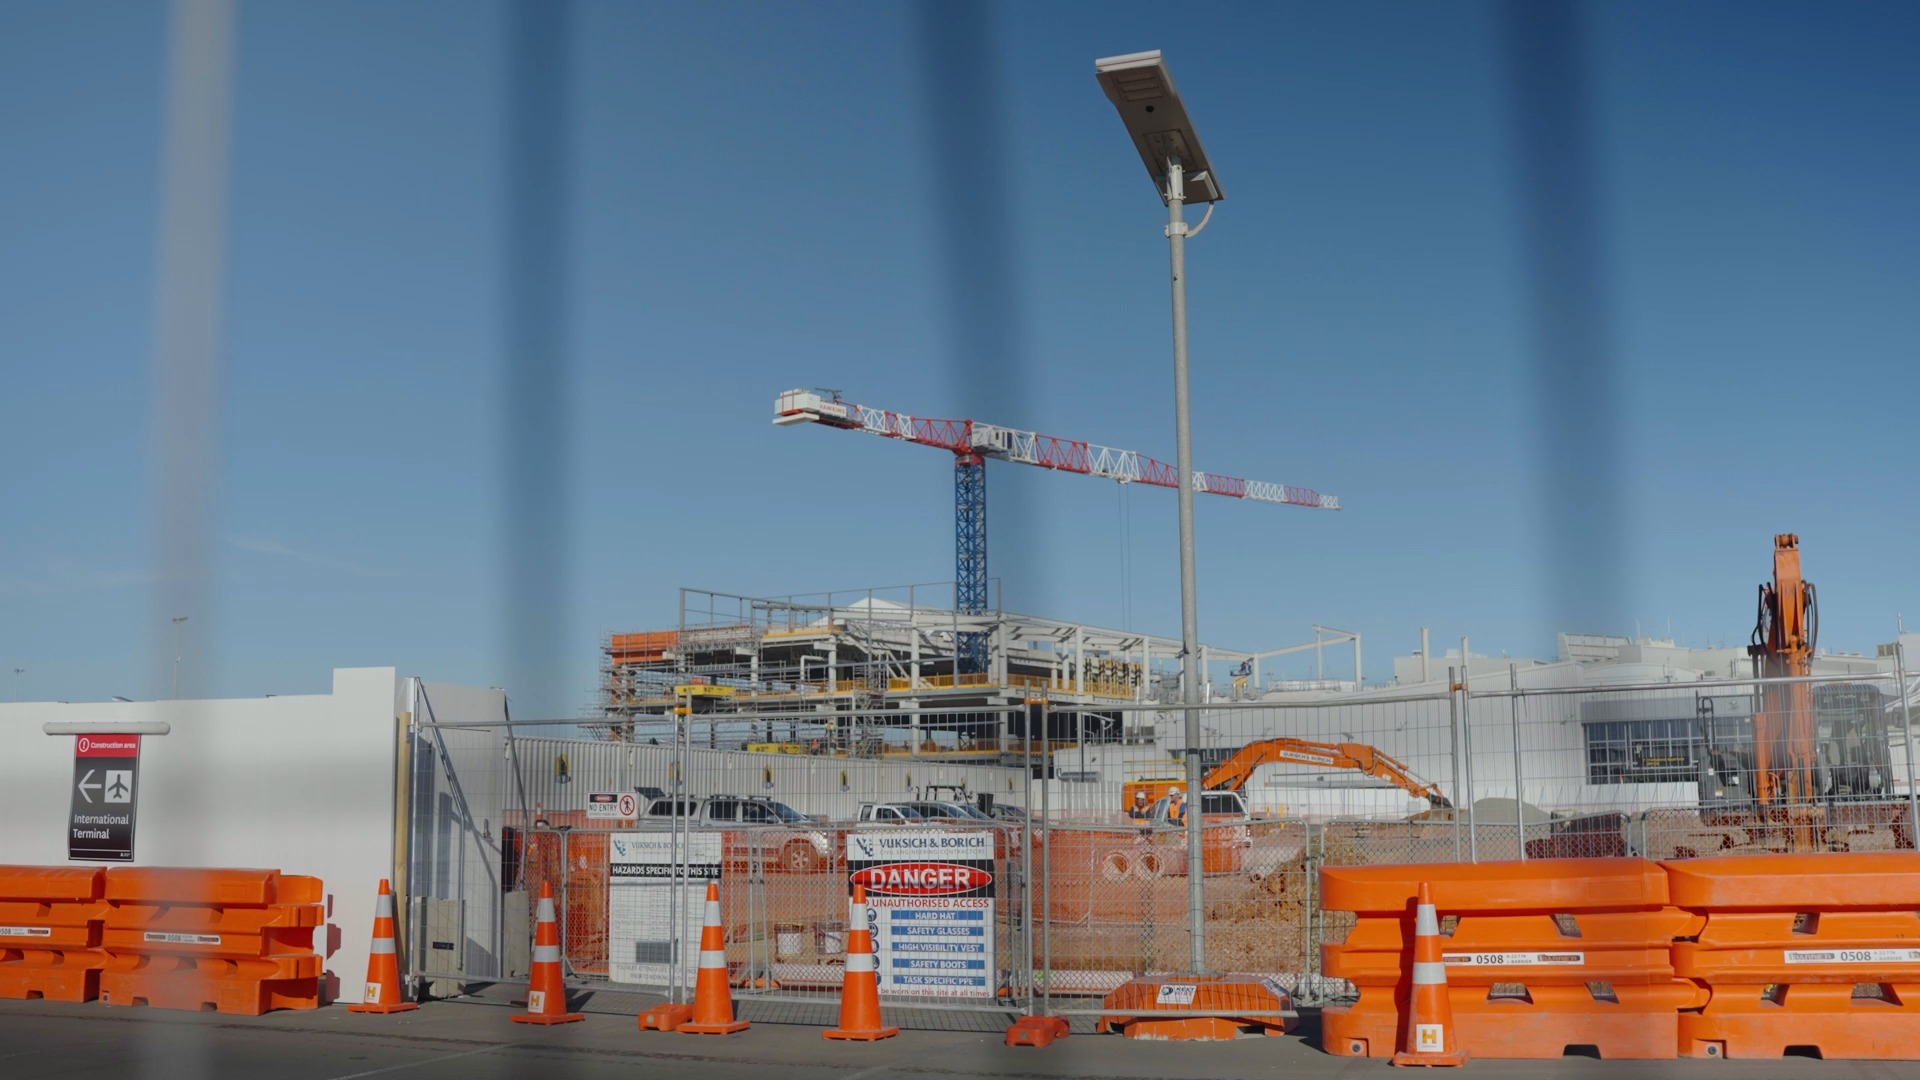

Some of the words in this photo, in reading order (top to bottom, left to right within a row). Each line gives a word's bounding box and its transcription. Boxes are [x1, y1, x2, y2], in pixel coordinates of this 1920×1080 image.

[74, 814, 129, 825] International
[73, 828, 109, 839] Terminal
[879, 838, 927, 848] VUKSICH
[930, 838, 939, 848] &
[941, 838, 985, 848] BORICH
[612, 866, 645, 875] HAZARDS
[646, 867, 674, 875] SPECIFI
[704, 868, 719, 876] SITE
[870, 868, 971, 889] DANGER
[872, 899, 950, 908] UNAUTHORISED
[953, 899, 989, 908] ACCESS
[915, 912, 938, 920] HARD
[940, 912, 956, 920] HAT
[0, 927, 11, 935] 508
[907, 927, 936, 935] SAFETY
[937, 927, 970, 936] GLASSES
[167, 934, 181, 942] 0508
[898, 943, 919, 951] HIGH
[920, 944, 960, 952] VISIBILITY
[961, 944, 980, 952] VEST
[1476, 954, 1504, 964] 0508
[1840, 951, 1872, 961] 0508
[910, 960, 939, 968] SAFETY
[940, 960, 967, 969] BOOTS
[903, 976, 923, 984] TASK
[924, 976, 957, 985] SPECIFIC
[959, 977, 973, 985] PPE
[367, 985, 377, 998] H
[530, 994, 541, 1007] H
[1422, 1029, 1437, 1044] H
